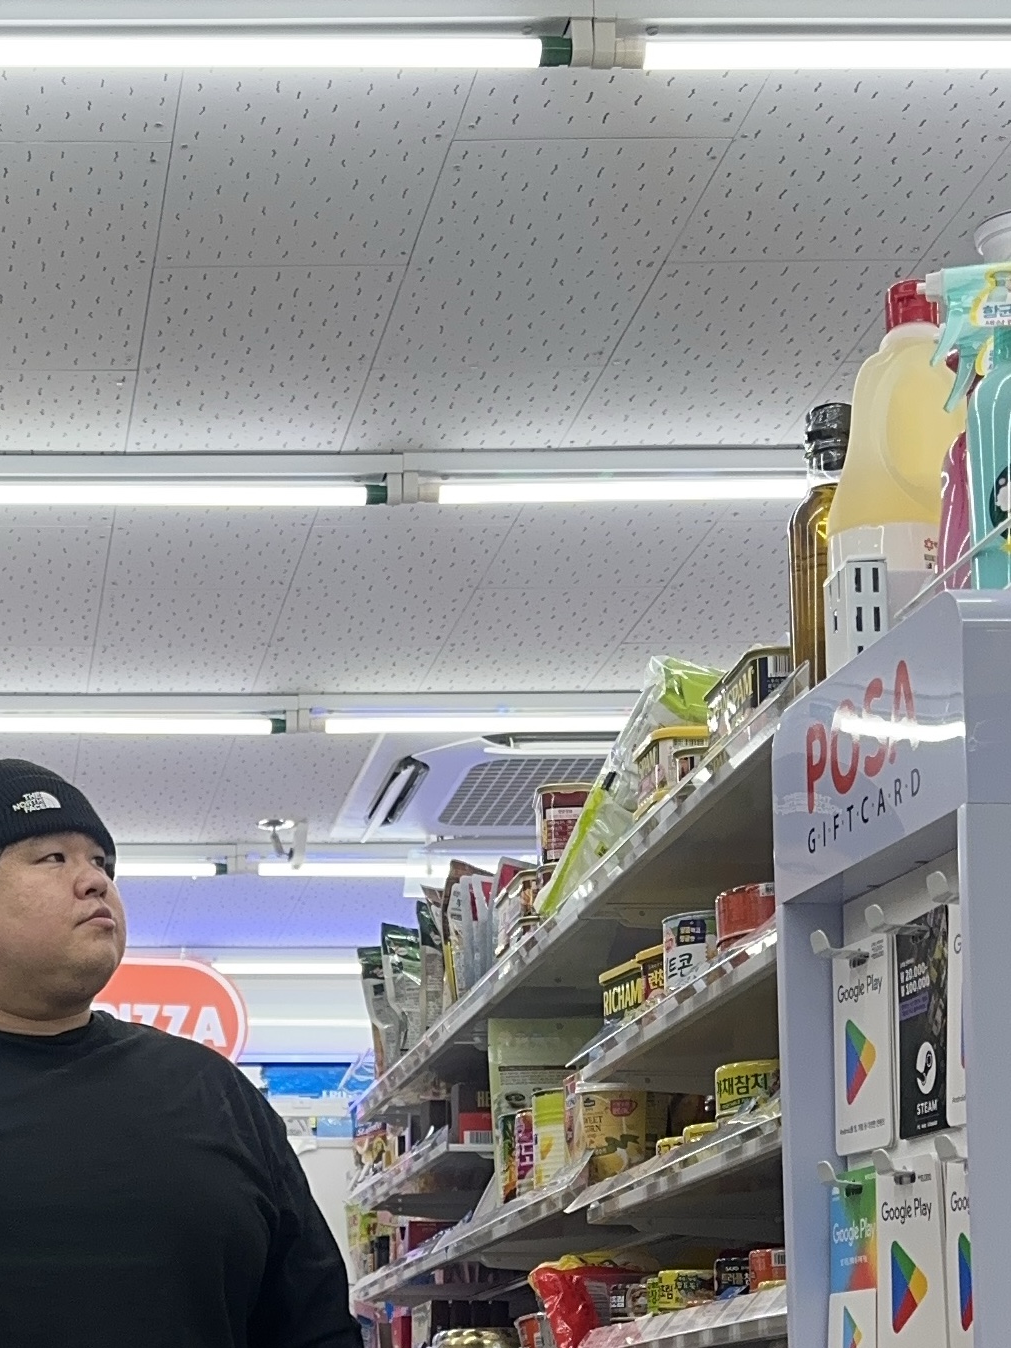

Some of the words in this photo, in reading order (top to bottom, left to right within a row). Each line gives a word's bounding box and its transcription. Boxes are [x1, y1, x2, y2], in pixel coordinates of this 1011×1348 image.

[806, 659, 916, 814] POSA
[603, 977, 643, 1017] RICHAM
[837, 978, 865, 1004] Google
[866, 973, 883, 994] Play
[916, 1098, 938, 1117] STEAM
[881, 1201, 912, 1225] Google
[914, 1198, 932, 1221] Play
[951, 1191, 970, 1215] Goog
[832, 1221, 859, 1247] Google
[859, 1218, 876, 1239] Play
